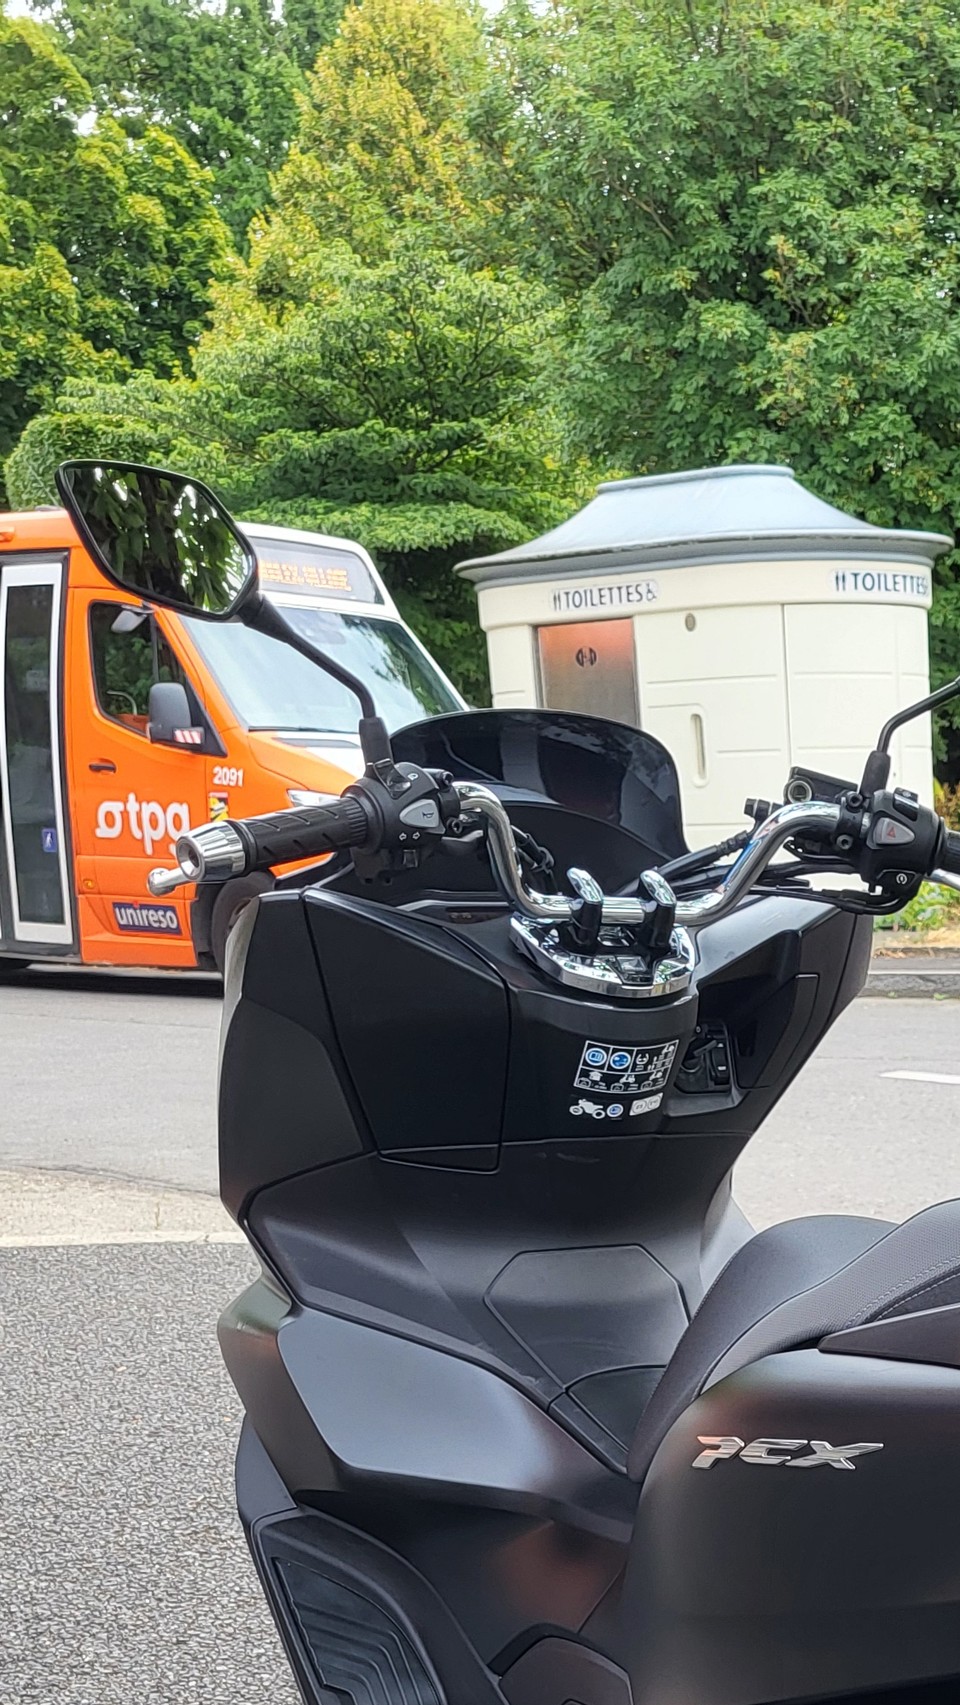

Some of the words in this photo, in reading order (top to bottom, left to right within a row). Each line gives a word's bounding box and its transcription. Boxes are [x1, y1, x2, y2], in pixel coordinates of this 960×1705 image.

[563, 583, 643, 609] TOILETTES
[213, 766, 244, 787] 2091
[114, 901, 178, 929] unireso
[692, 1436, 884, 1470] PCX
